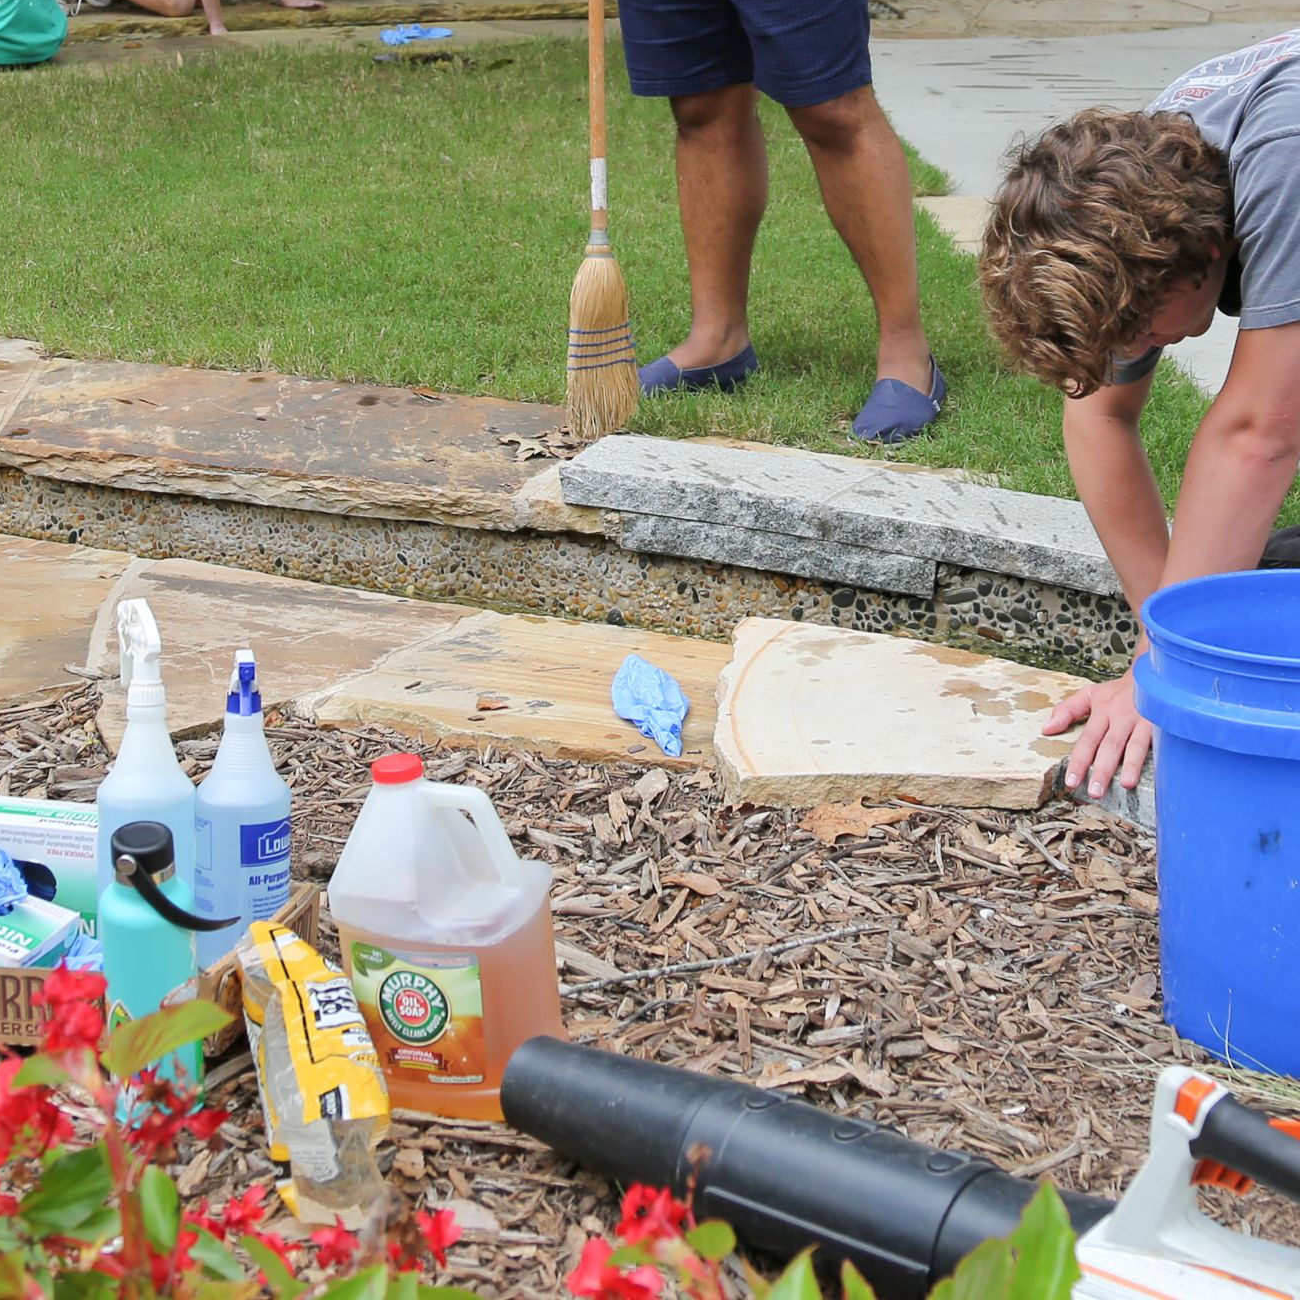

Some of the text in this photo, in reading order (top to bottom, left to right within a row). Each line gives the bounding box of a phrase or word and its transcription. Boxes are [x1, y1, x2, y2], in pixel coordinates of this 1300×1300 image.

[381, 972, 444, 1008] MURPHY
[402, 996, 420, 1007] OIL
[399, 1006, 425, 1017] SOAP
[402, 1028, 427, 1038] CLEANS
